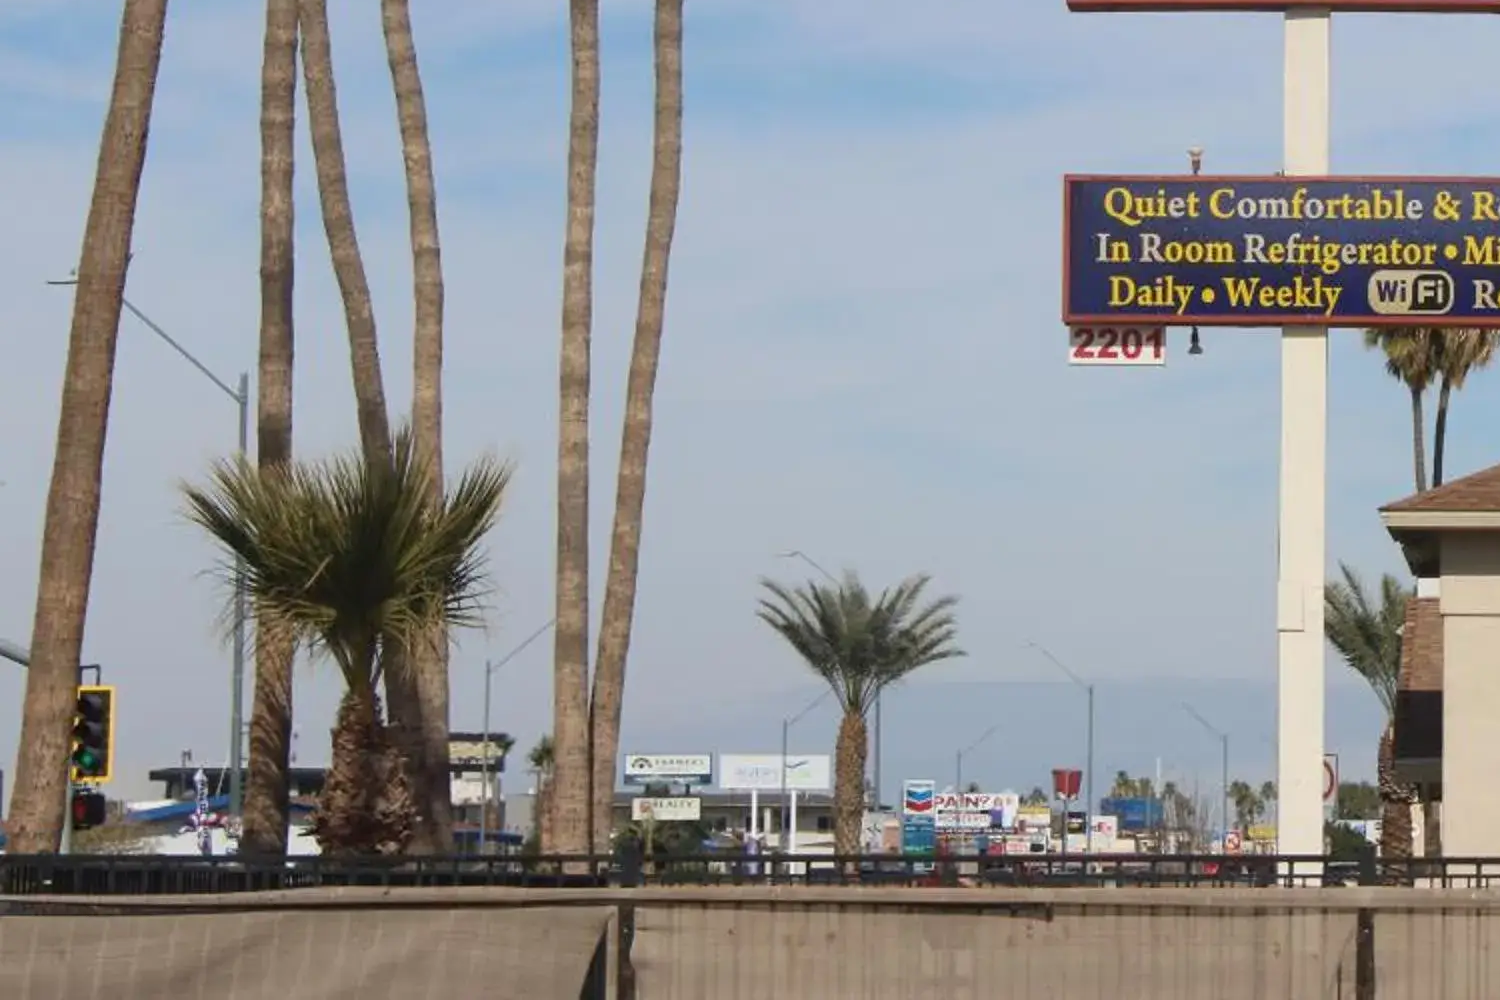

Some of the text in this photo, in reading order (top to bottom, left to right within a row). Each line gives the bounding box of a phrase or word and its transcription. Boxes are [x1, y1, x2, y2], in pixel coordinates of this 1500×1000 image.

[1104, 187, 1199, 226] Quiet
[1210, 187, 1423, 221] Comfortable
[1432, 191, 1461, 221] &
[1095, 233, 1131, 263] In
[1139, 233, 1235, 264] Room
[1242, 233, 1436, 274] Refrigerator
[1109, 275, 1195, 315] Daily
[1222, 275, 1344, 316] Weekly
[1073, 327, 1165, 360] 2201
